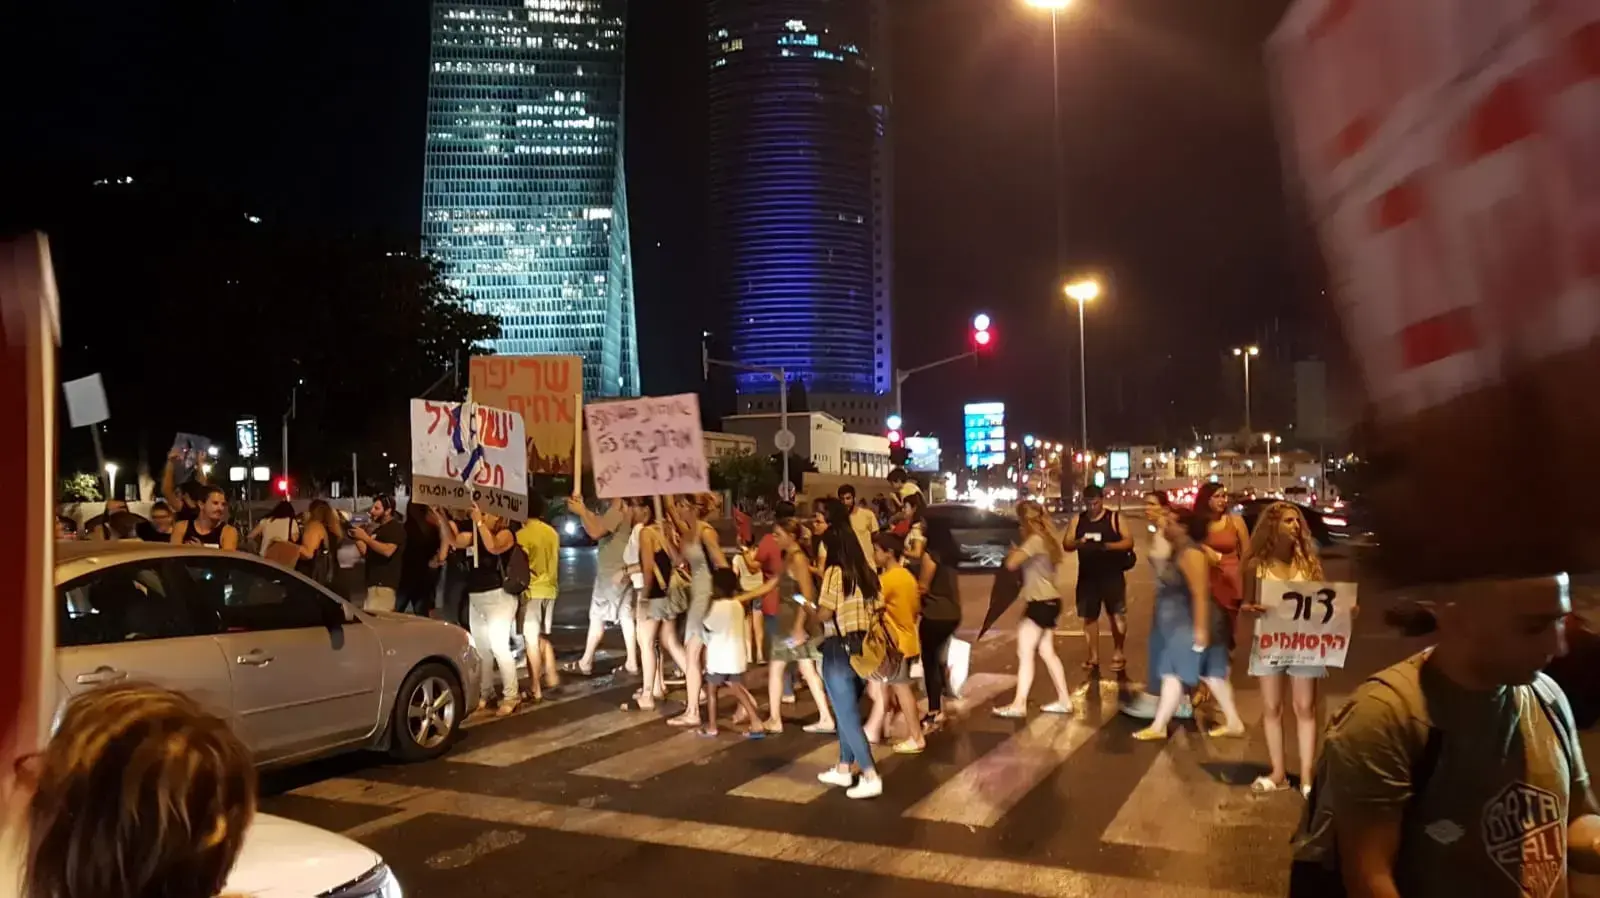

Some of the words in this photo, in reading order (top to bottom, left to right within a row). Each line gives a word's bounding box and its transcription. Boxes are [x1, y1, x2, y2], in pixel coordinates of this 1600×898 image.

[471, 358, 569, 392] שריפה
[1281, 588, 1337, 625] דור
[1260, 632, 1346, 658] הקסאמים
[1486, 786, 1558, 843] BAJA
